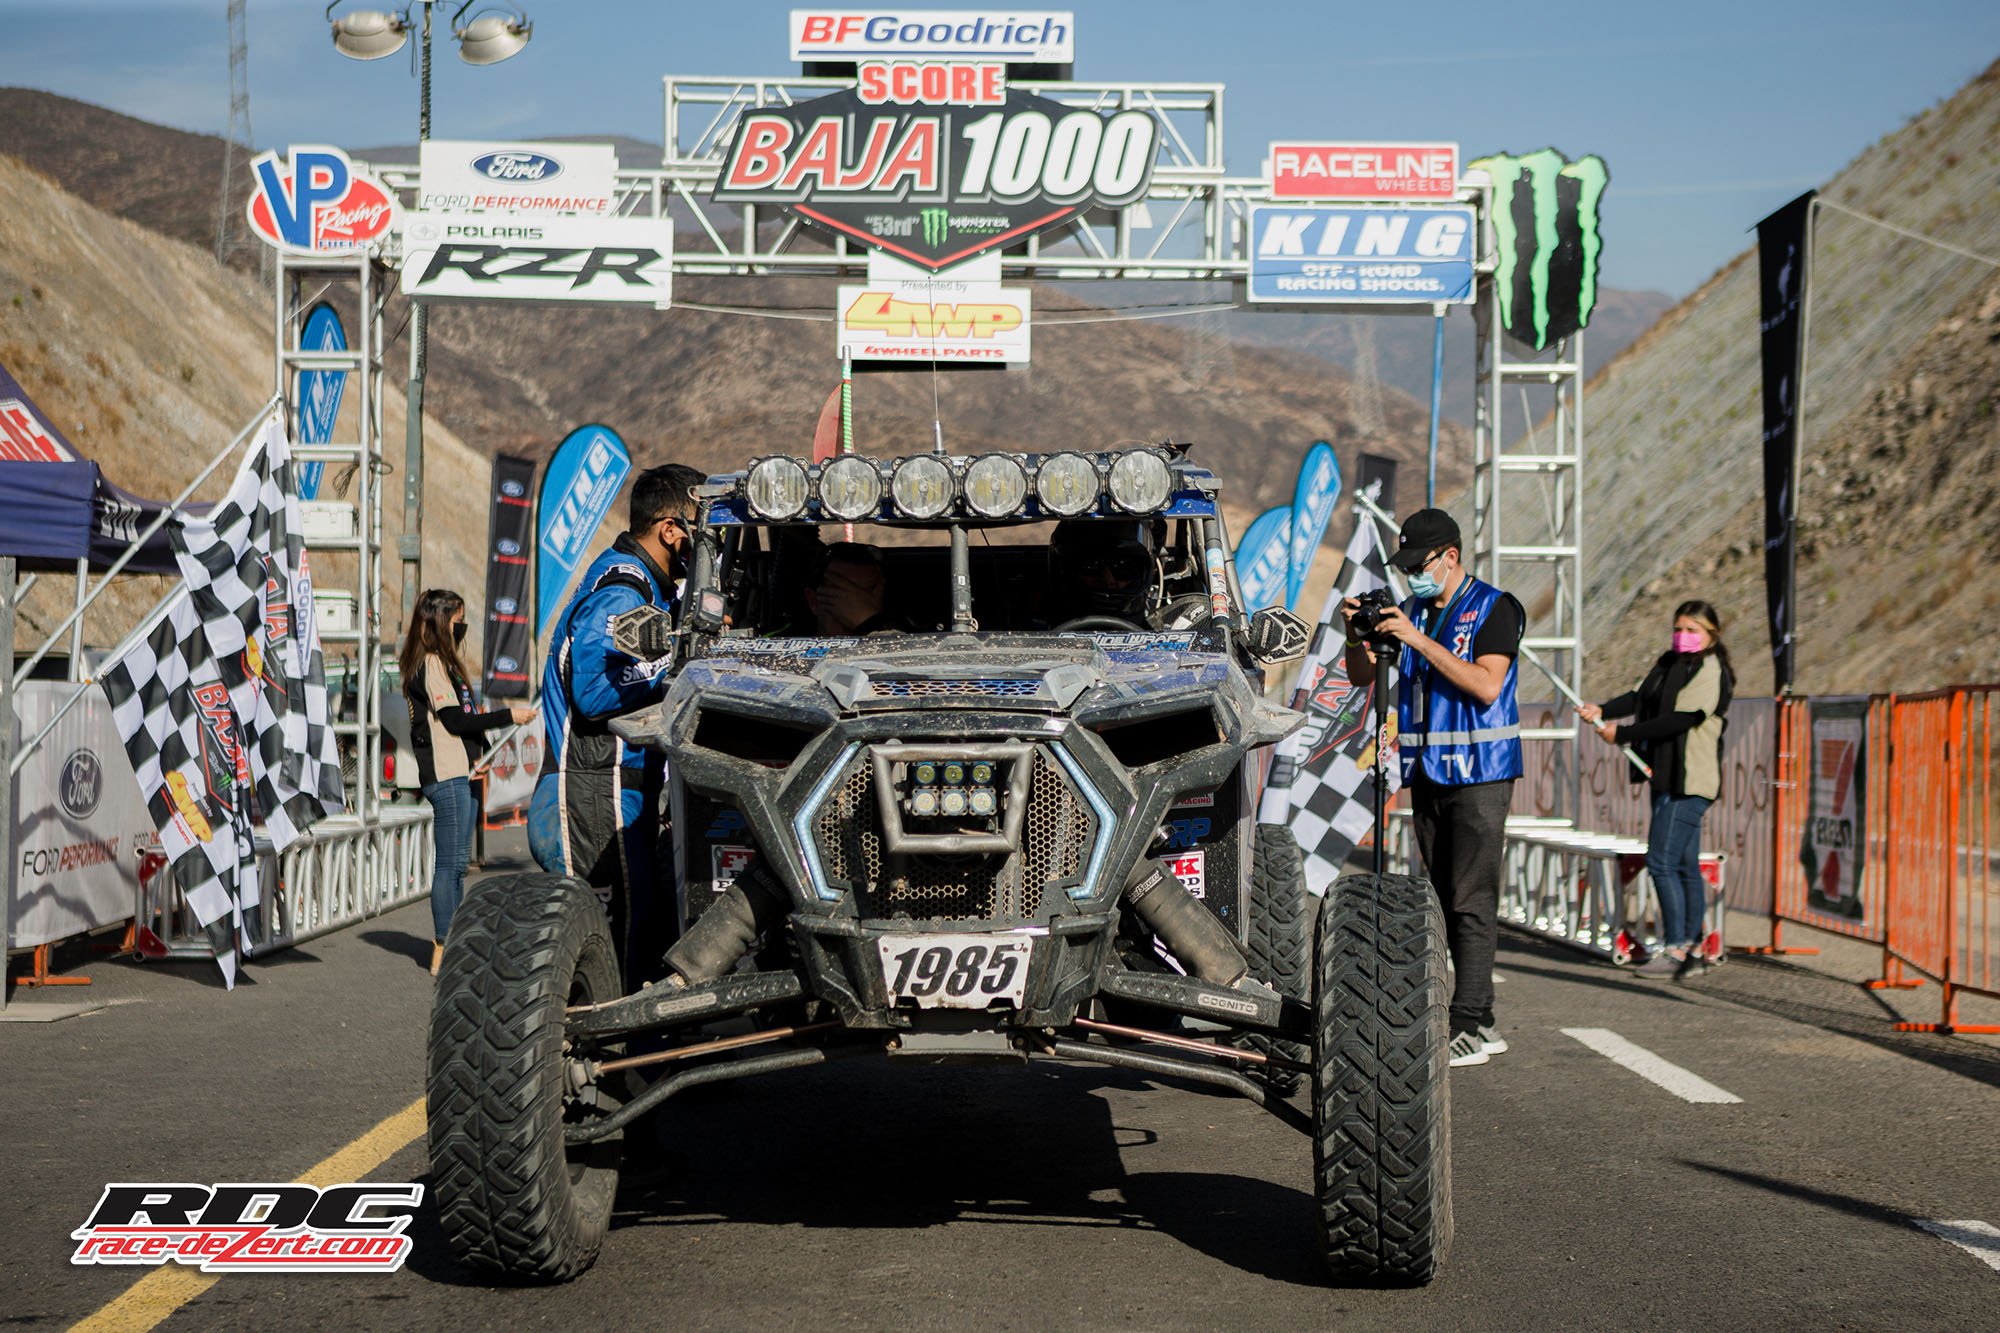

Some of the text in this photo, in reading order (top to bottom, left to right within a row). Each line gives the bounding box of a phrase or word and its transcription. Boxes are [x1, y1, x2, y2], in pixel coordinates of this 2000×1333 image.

[801, 17, 1066, 45] BFGoodrich
[861, 65, 1004, 102] SCORE
[486, 152, 548, 181] Ford
[724, 112, 1156, 197] BAJA 1000
[1275, 154, 1452, 179] RACELINE
[1375, 179, 1452, 192] WHEELS
[257, 153, 349, 250] VP
[423, 194, 609, 211] FORD PERFORMANCE
[317, 202, 391, 237] Racing
[447, 225, 543, 240] POLARIS
[318, 240, 367, 250] FUELS
[1258, 215, 1468, 257] KING
[416, 243, 663, 292] RZR
[1302, 263, 1345, 278] OFF
[1358, 264, 1422, 278] ROAD
[902, 280, 968, 292] Presented by
[1277, 277, 1357, 292] RACING
[845, 291, 1023, 338] 4WP
[550, 442, 610, 555] KING
[1128, 634, 1193, 643] WRAPS
[1402, 757, 1415, 778] 7
[1441, 754, 1475, 778] TV
[22, 847, 60, 877] FORD
[891, 942, 1025, 997] 1985
[1201, 995, 1256, 1014] COGNITO
